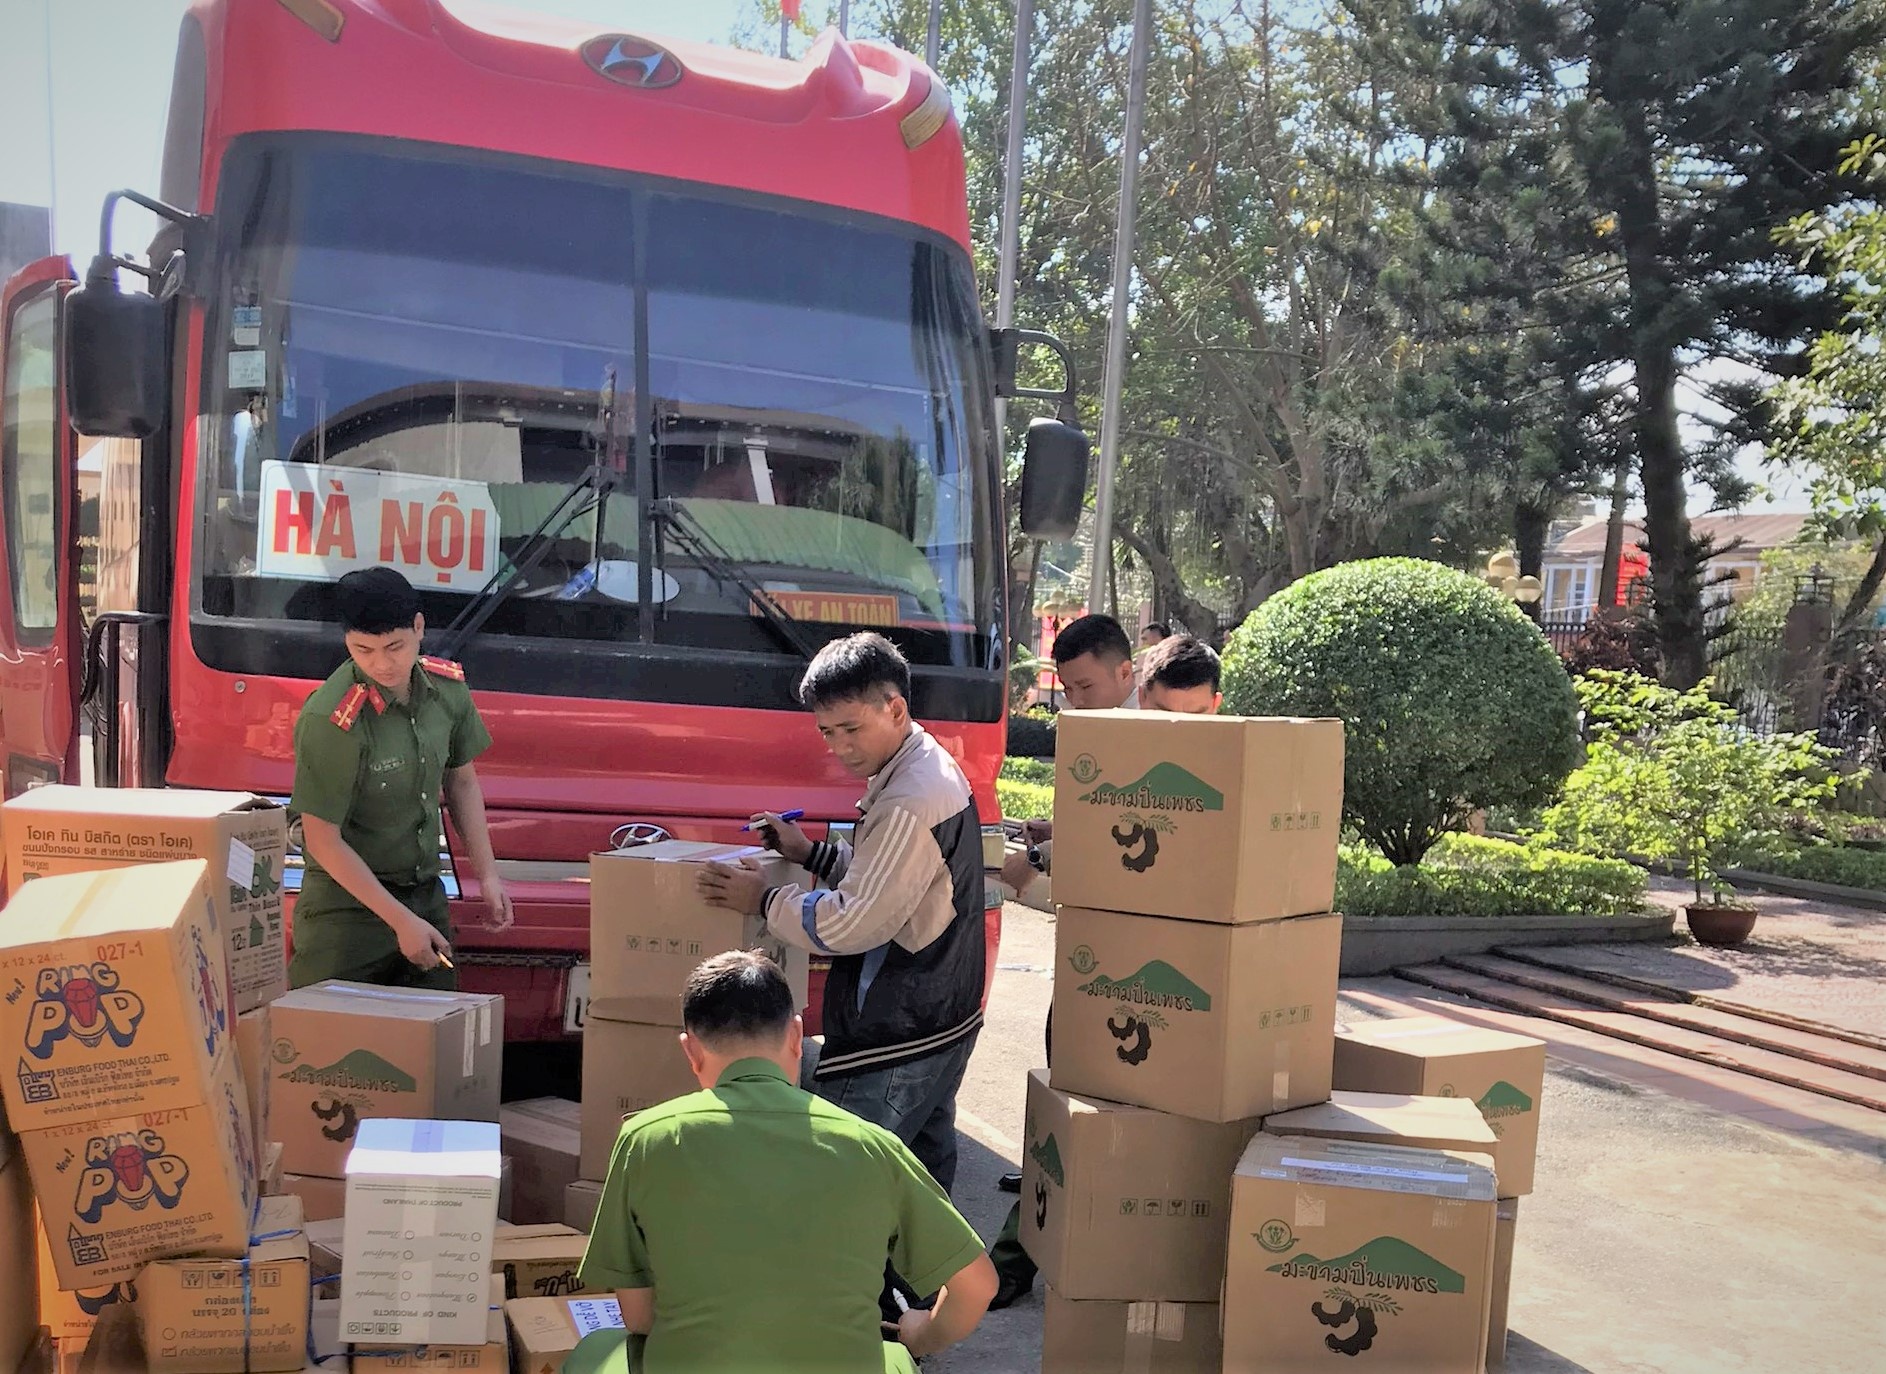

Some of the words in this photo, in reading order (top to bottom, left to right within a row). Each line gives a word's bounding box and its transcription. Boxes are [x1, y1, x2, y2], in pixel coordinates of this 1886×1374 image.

[273, 479, 357, 559] HÀ
[380, 491, 486, 583] NỘI
[793, 600, 814, 621] XE
[820, 601, 843, 623] AN
[1090, 780, 1204, 812] มะขามปิ่นเพชร
[27, 825, 55, 841] โอเค
[160, 832, 193, 850] โอเค)
[12, 955, 25, 966] 12
[38, 953, 50, 964] 24
[97, 941, 143, 962] 027-1
[36, 961, 120, 1001] RING
[1087, 976, 1193, 1011] มะขามปิ่นเพชร
[25, 989, 145, 1060] POP
[57, 1065, 92, 1076] ENBURG
[93, 1061, 117, 1071] FOOD
[117, 1057, 137, 1068] THAI
[62, 1125, 74, 1136] 12
[87, 1121, 99, 1132] 24
[143, 1108, 189, 1127] 027-1
[85, 1129, 166, 1168] RING
[74, 1155, 190, 1224] POP
[106, 1226, 139, 1239] ENBURG
[140, 1222, 163, 1233] FOOD
[1281, 1254, 1438, 1294] มะขามปิ่นเพชร
[222, 1307, 237, 1317] 20
[373, 1309, 418, 1318] PRODUCTS
[422, 1310, 434, 1318] OF
[437, 1310, 458, 1318] KIND
